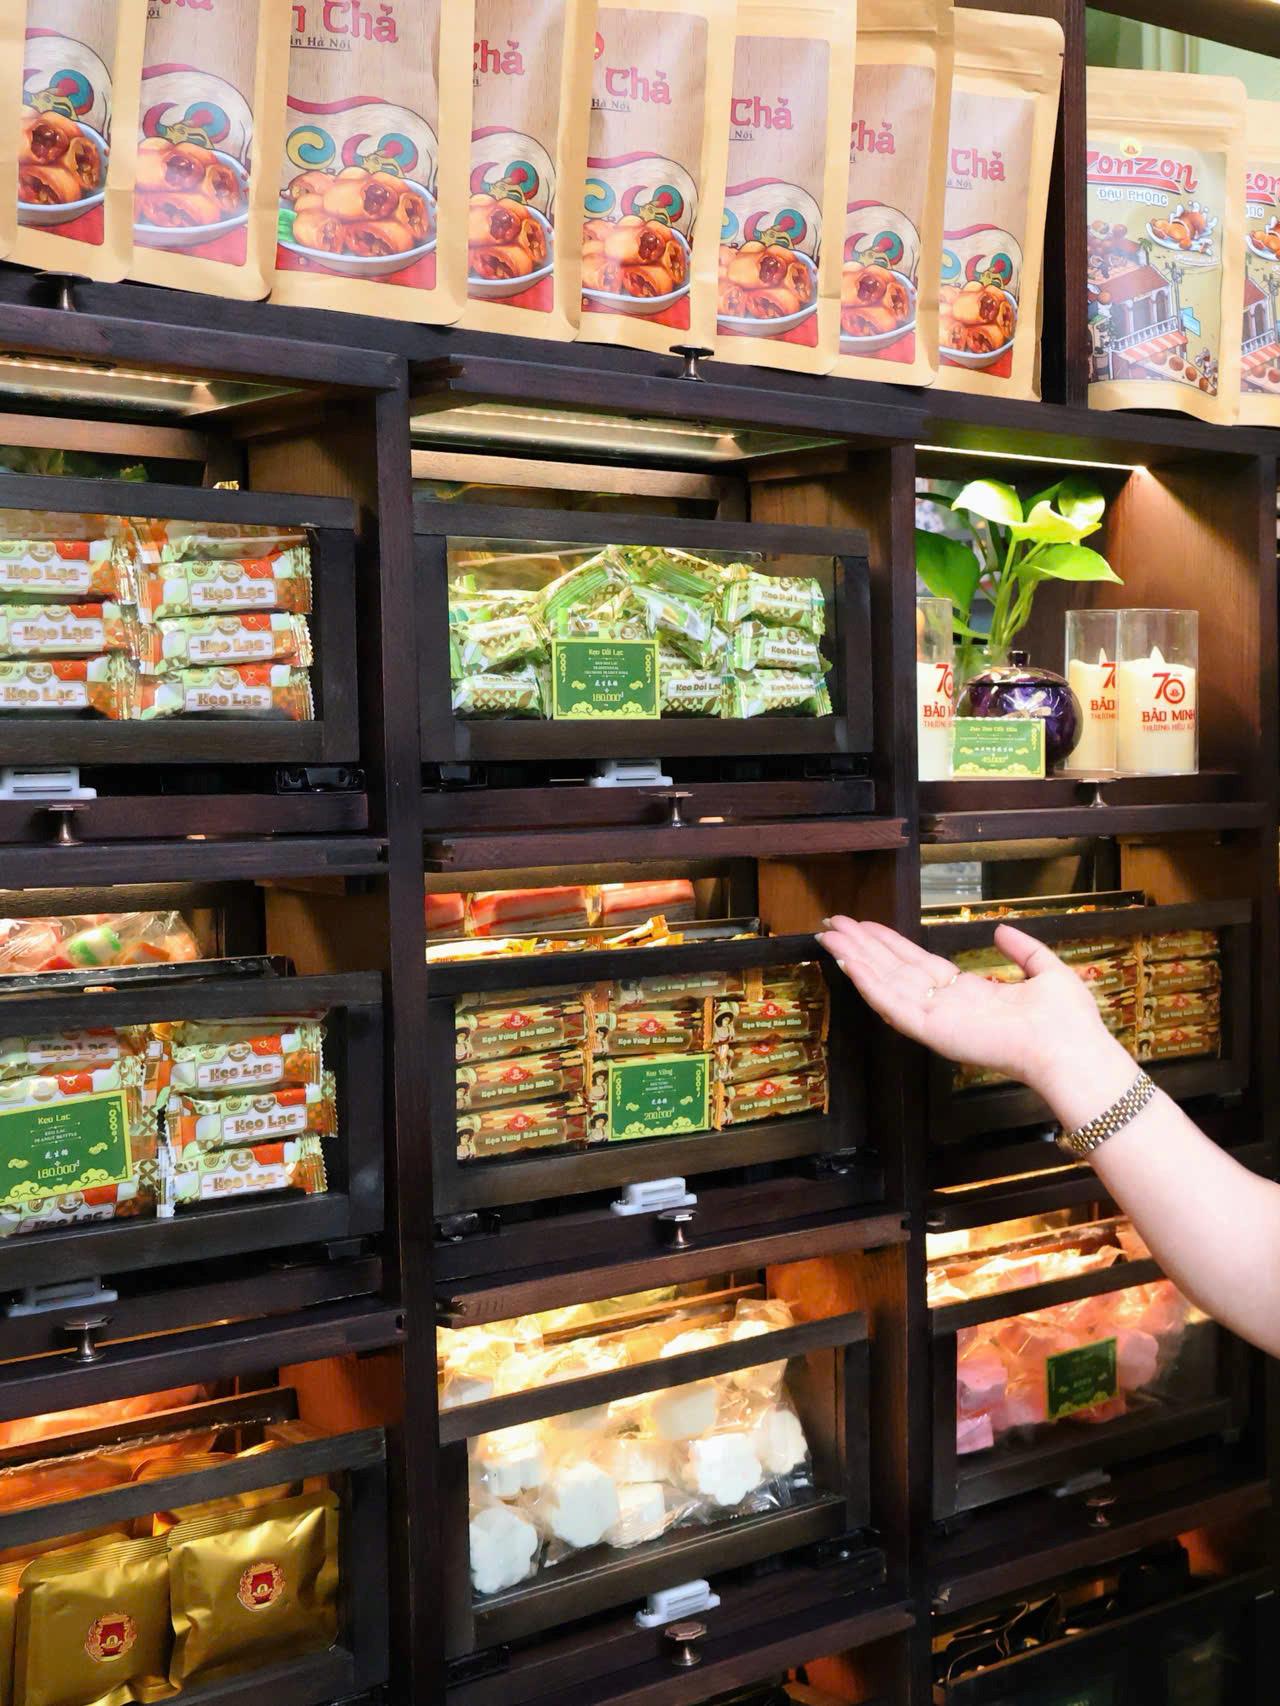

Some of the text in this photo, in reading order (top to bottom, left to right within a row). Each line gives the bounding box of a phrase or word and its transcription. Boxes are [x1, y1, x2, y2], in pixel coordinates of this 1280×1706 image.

[323, 0, 399, 43] Chả
[473, 39, 525, 75] hả
[605, 66, 672, 104] Chả
[731, 96, 793, 130] Chả
[851, 119, 896, 155] hả
[951, 148, 1006, 182] Chả
[1152, 673, 1185, 704] 70
